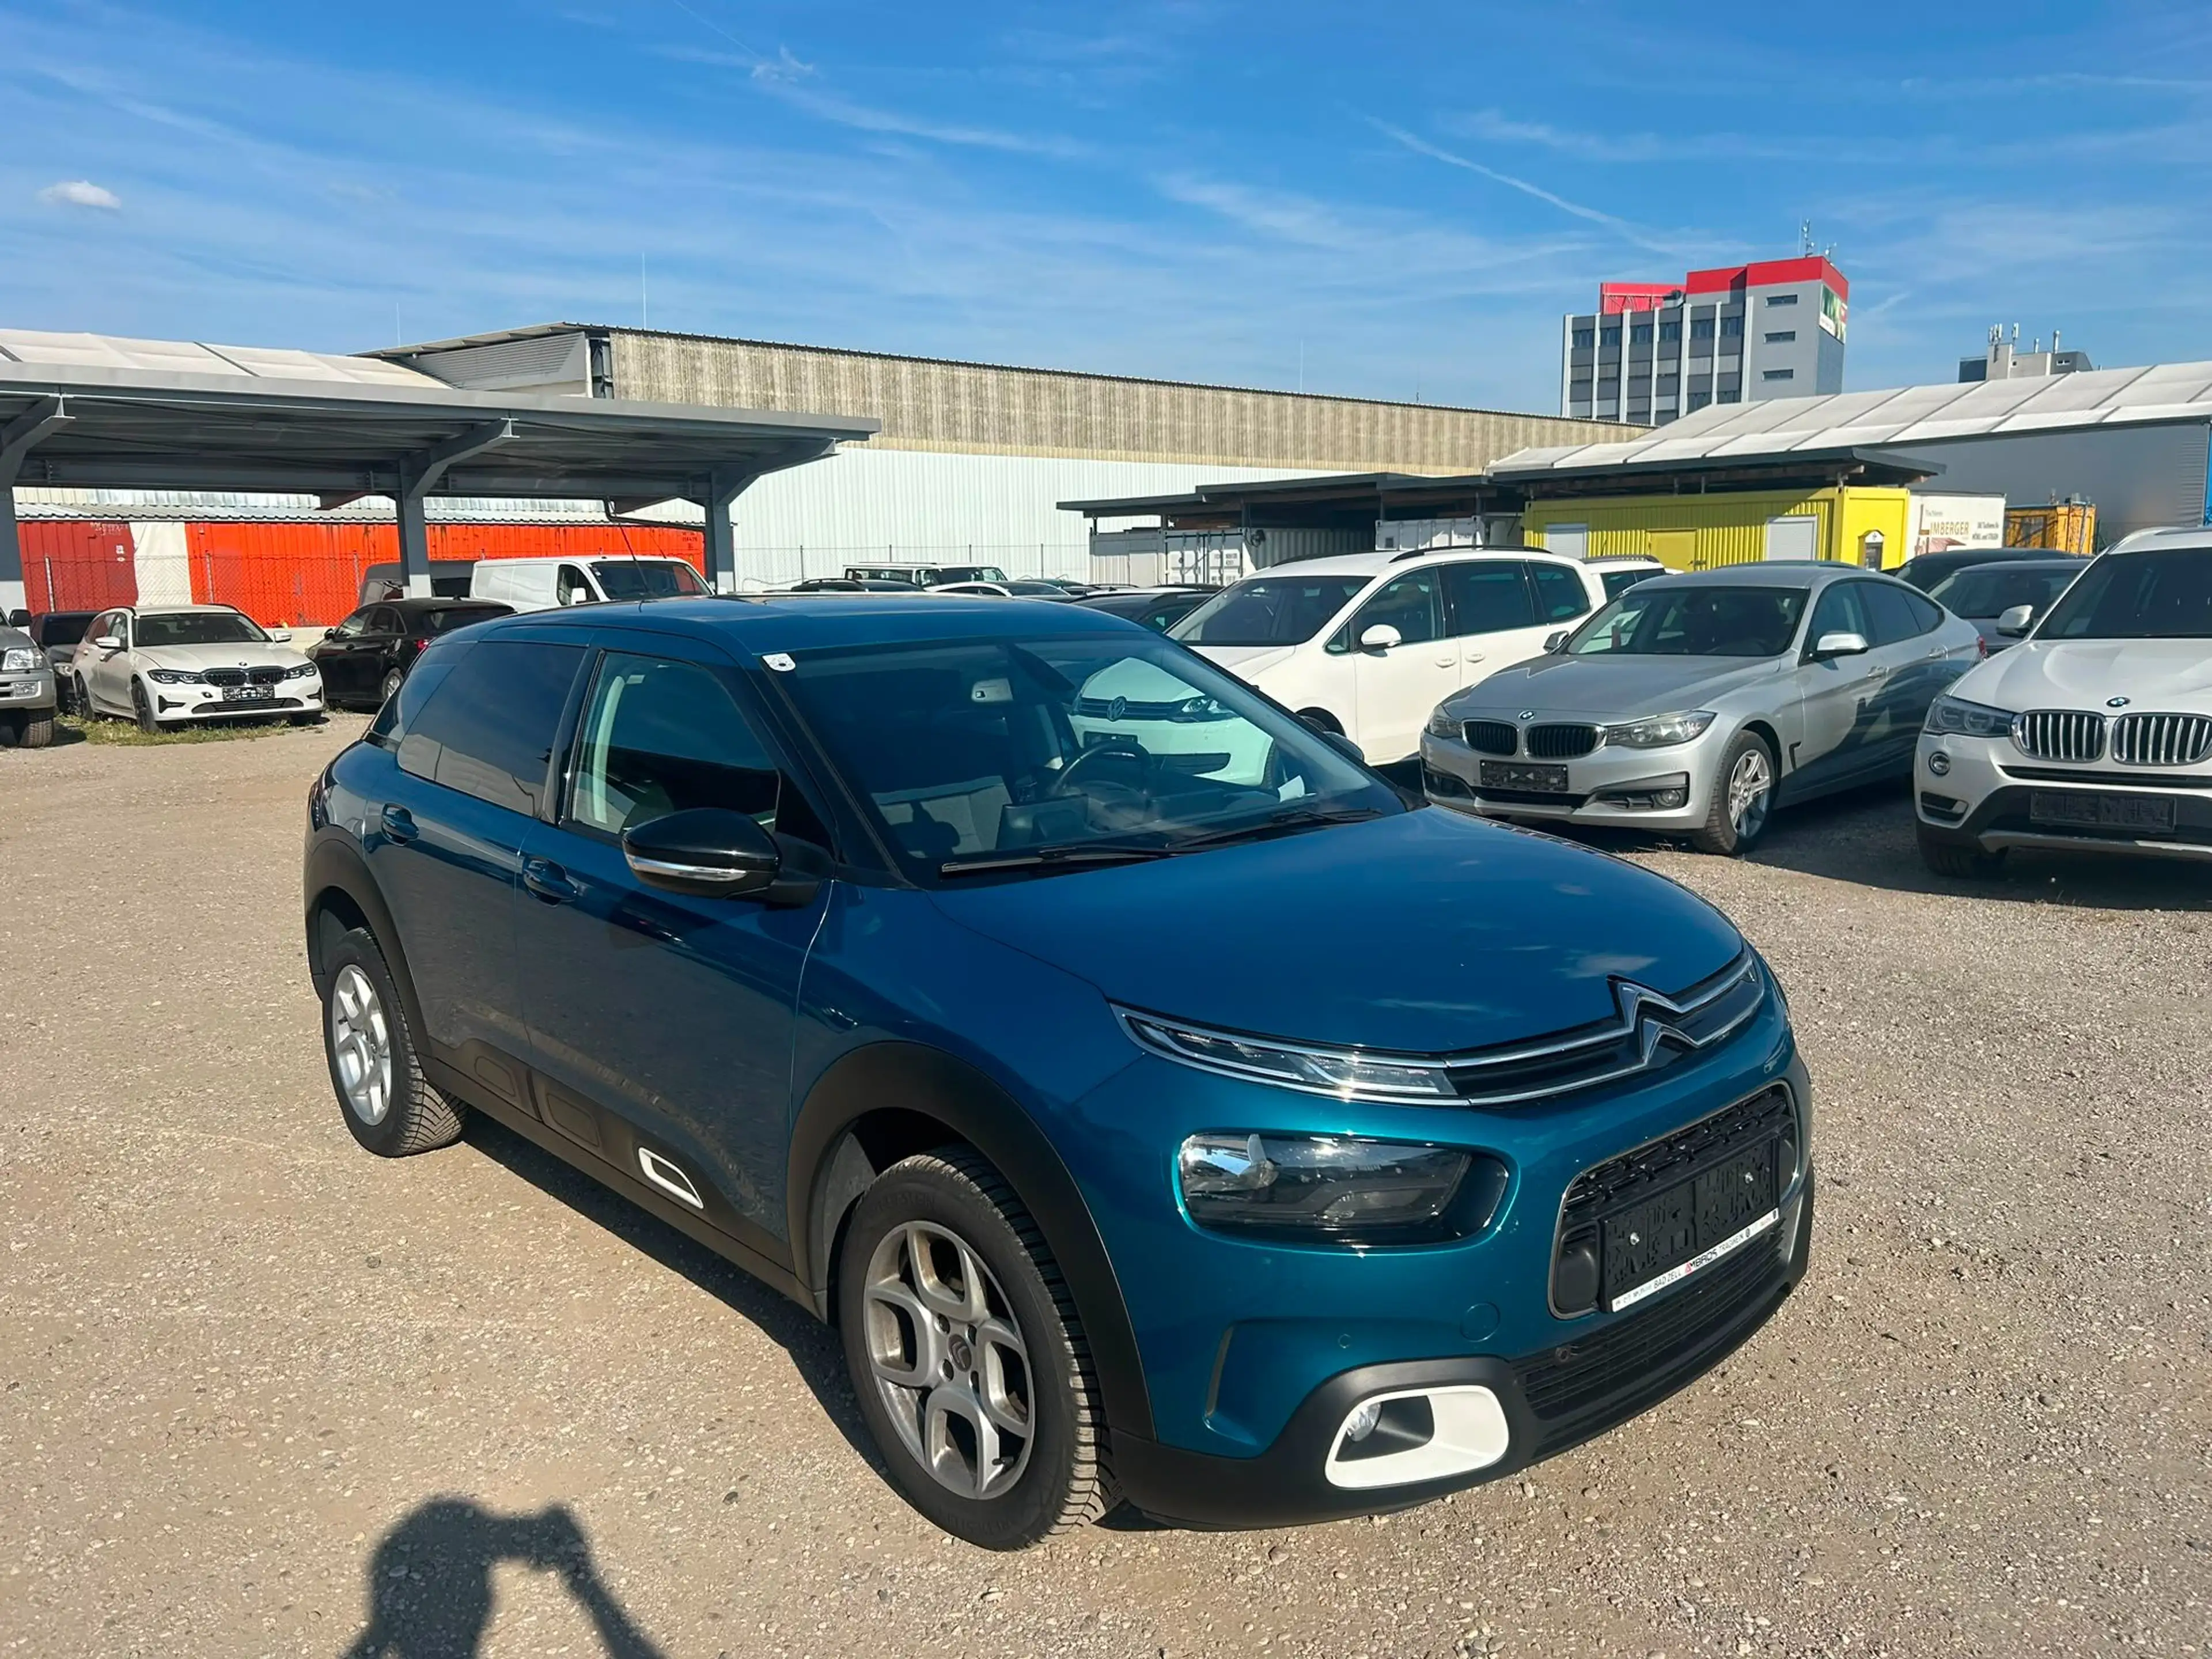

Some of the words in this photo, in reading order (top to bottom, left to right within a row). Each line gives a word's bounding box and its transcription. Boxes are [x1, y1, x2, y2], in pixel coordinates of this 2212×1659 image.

[1653, 1276, 1666, 1289] BAD
[1667, 1268, 1681, 1282] ZELL
[1684, 1248, 1718, 1275] AMBROS
